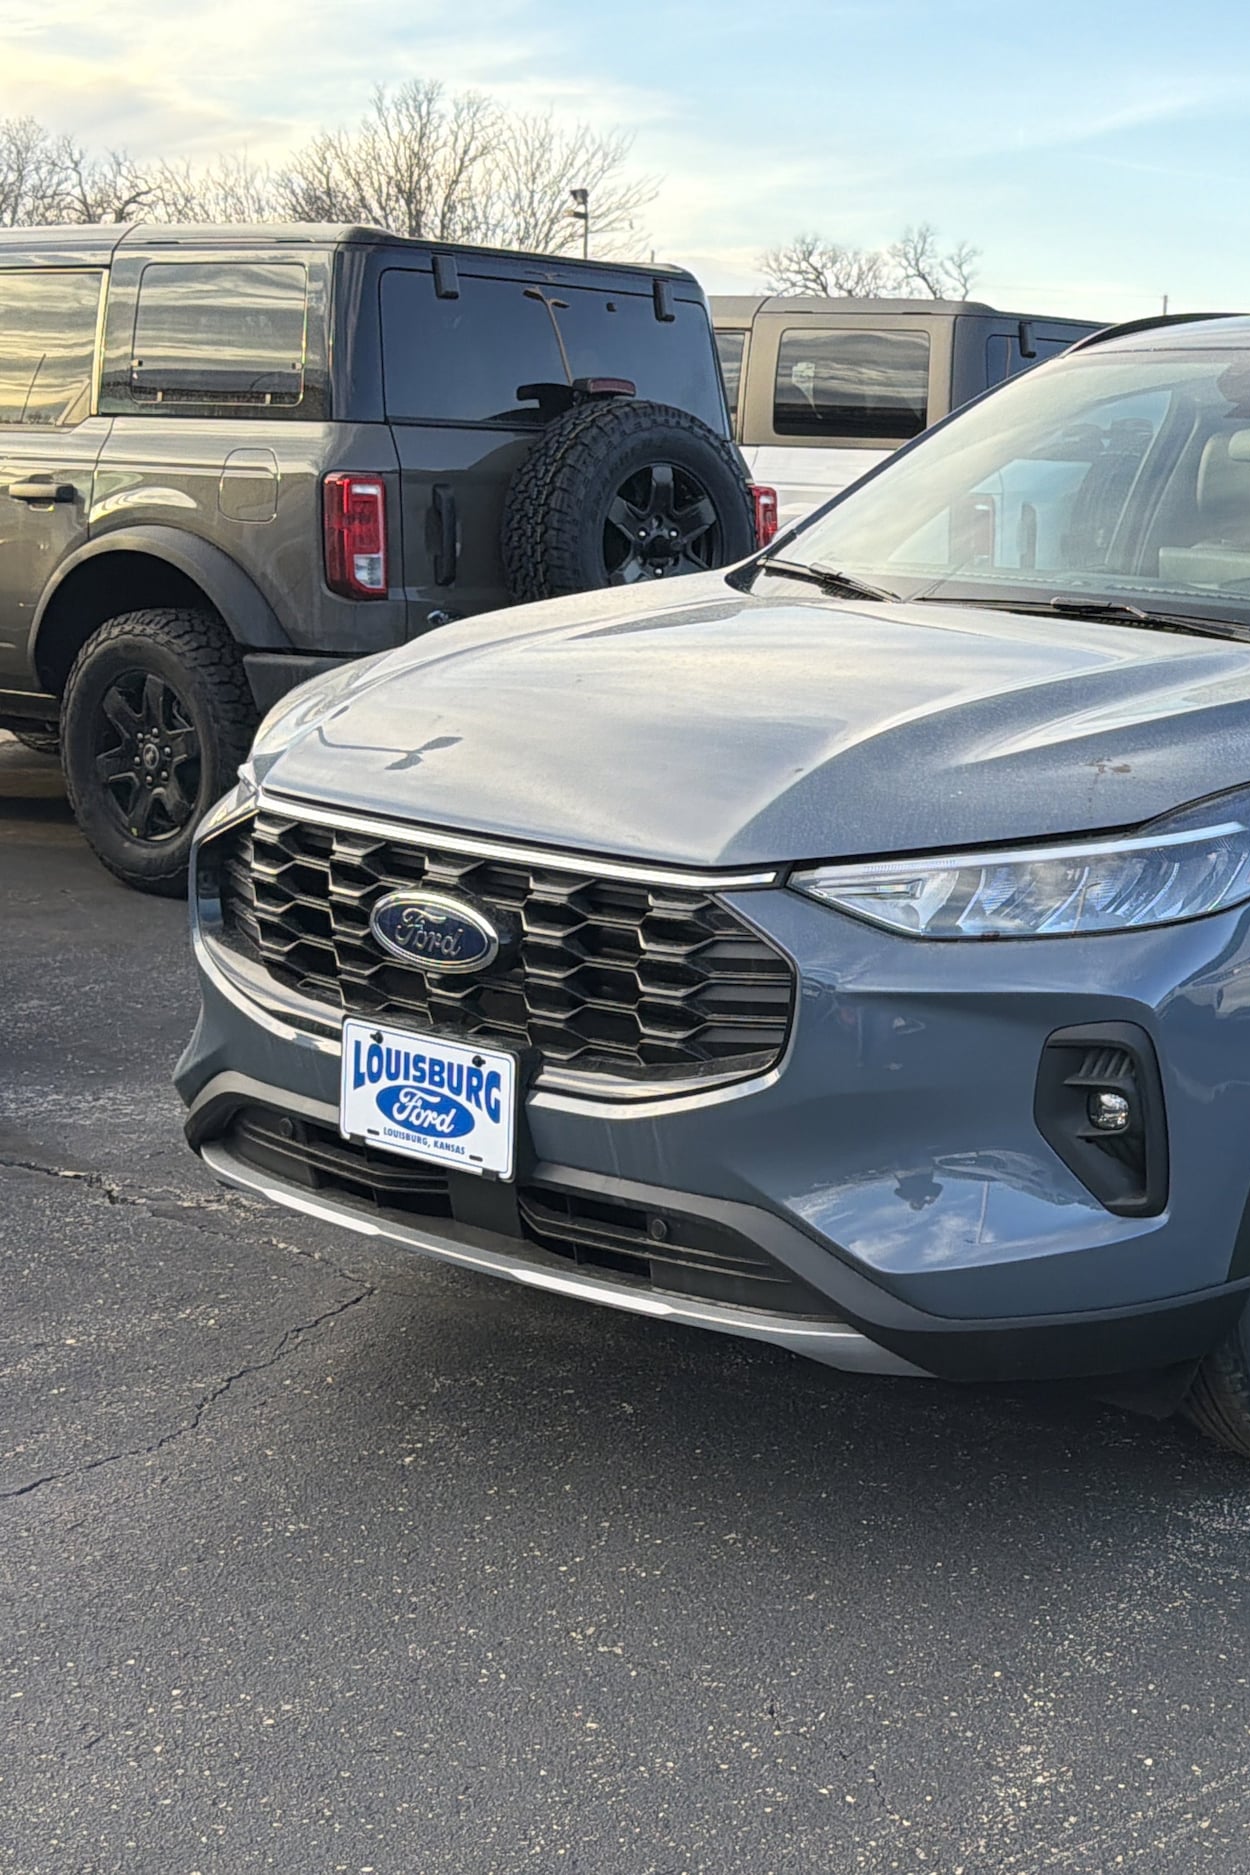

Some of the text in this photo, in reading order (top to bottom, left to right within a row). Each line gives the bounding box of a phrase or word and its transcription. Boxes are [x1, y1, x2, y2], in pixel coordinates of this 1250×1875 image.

[395, 907, 464, 957] Ford
[353, 1040, 502, 1124] LOUISBURG
[392, 1088, 455, 1134] Ford
[383, 1127, 465, 1155] LOUISBURG, KANSAS
